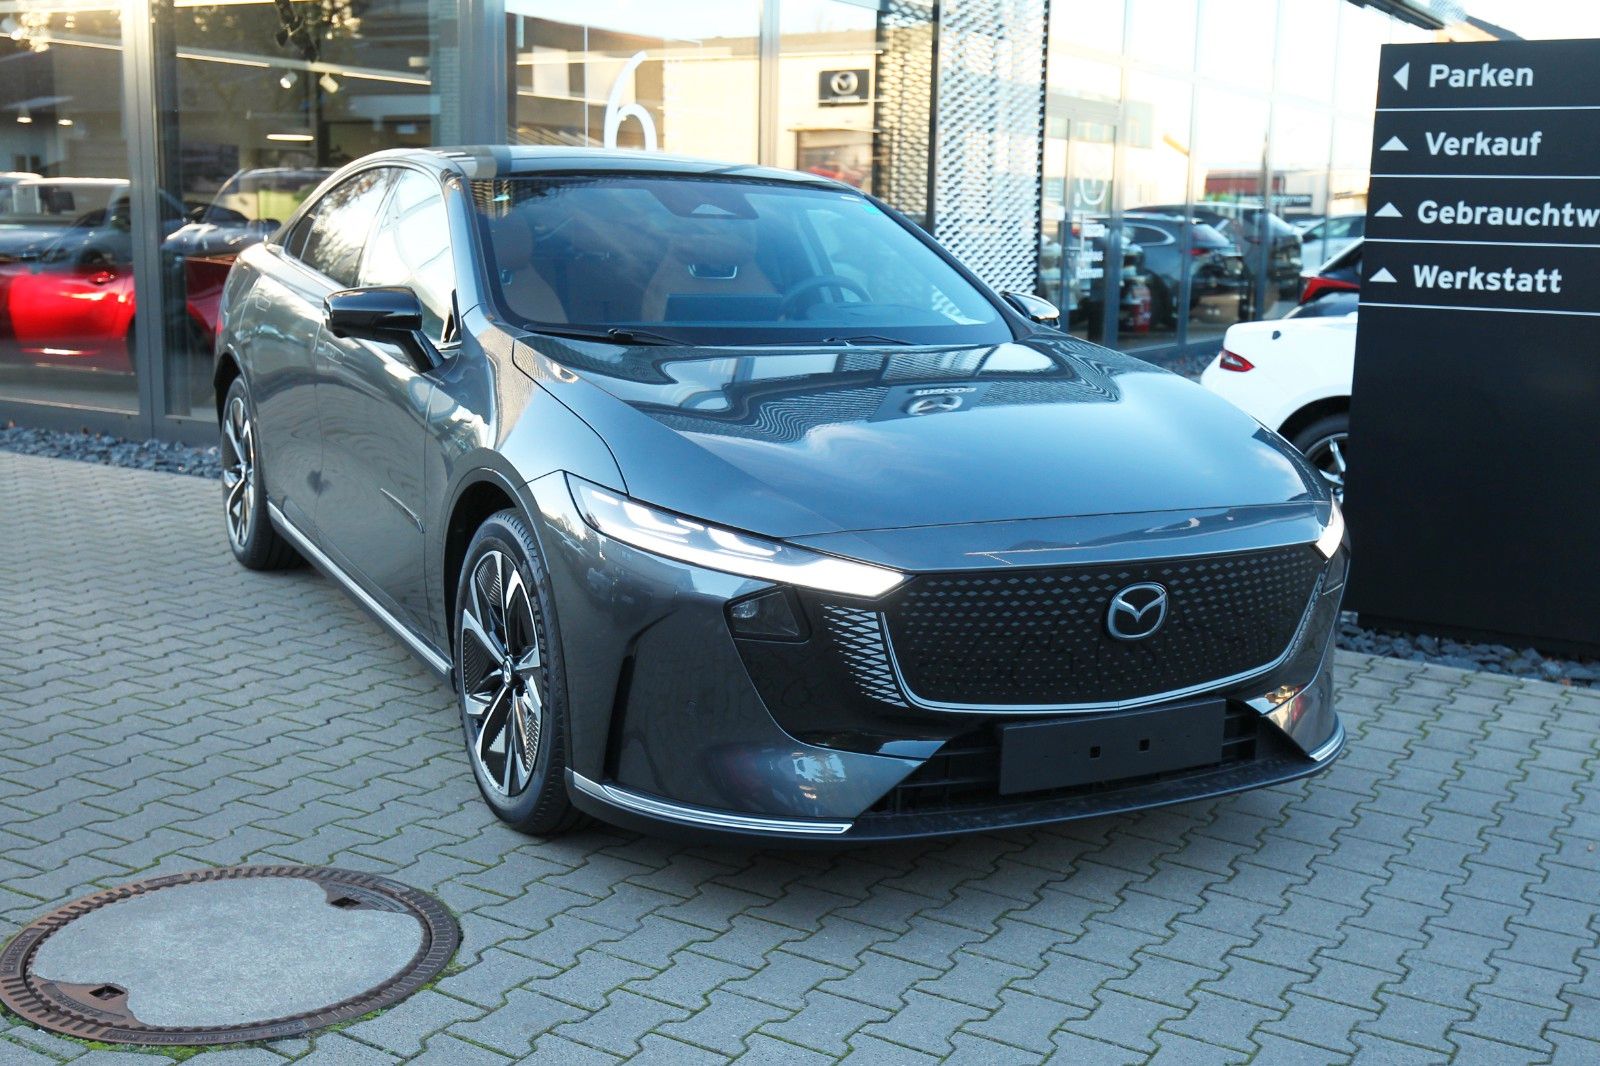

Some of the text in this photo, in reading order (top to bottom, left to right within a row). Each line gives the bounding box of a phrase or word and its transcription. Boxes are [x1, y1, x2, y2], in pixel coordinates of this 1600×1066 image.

[1428, 62, 1534, 88] Parken
[1425, 130, 1542, 157] Verkauf
[1416, 200, 1600, 228] Gebrauchtw
[1412, 264, 1563, 294] Werkstatt
